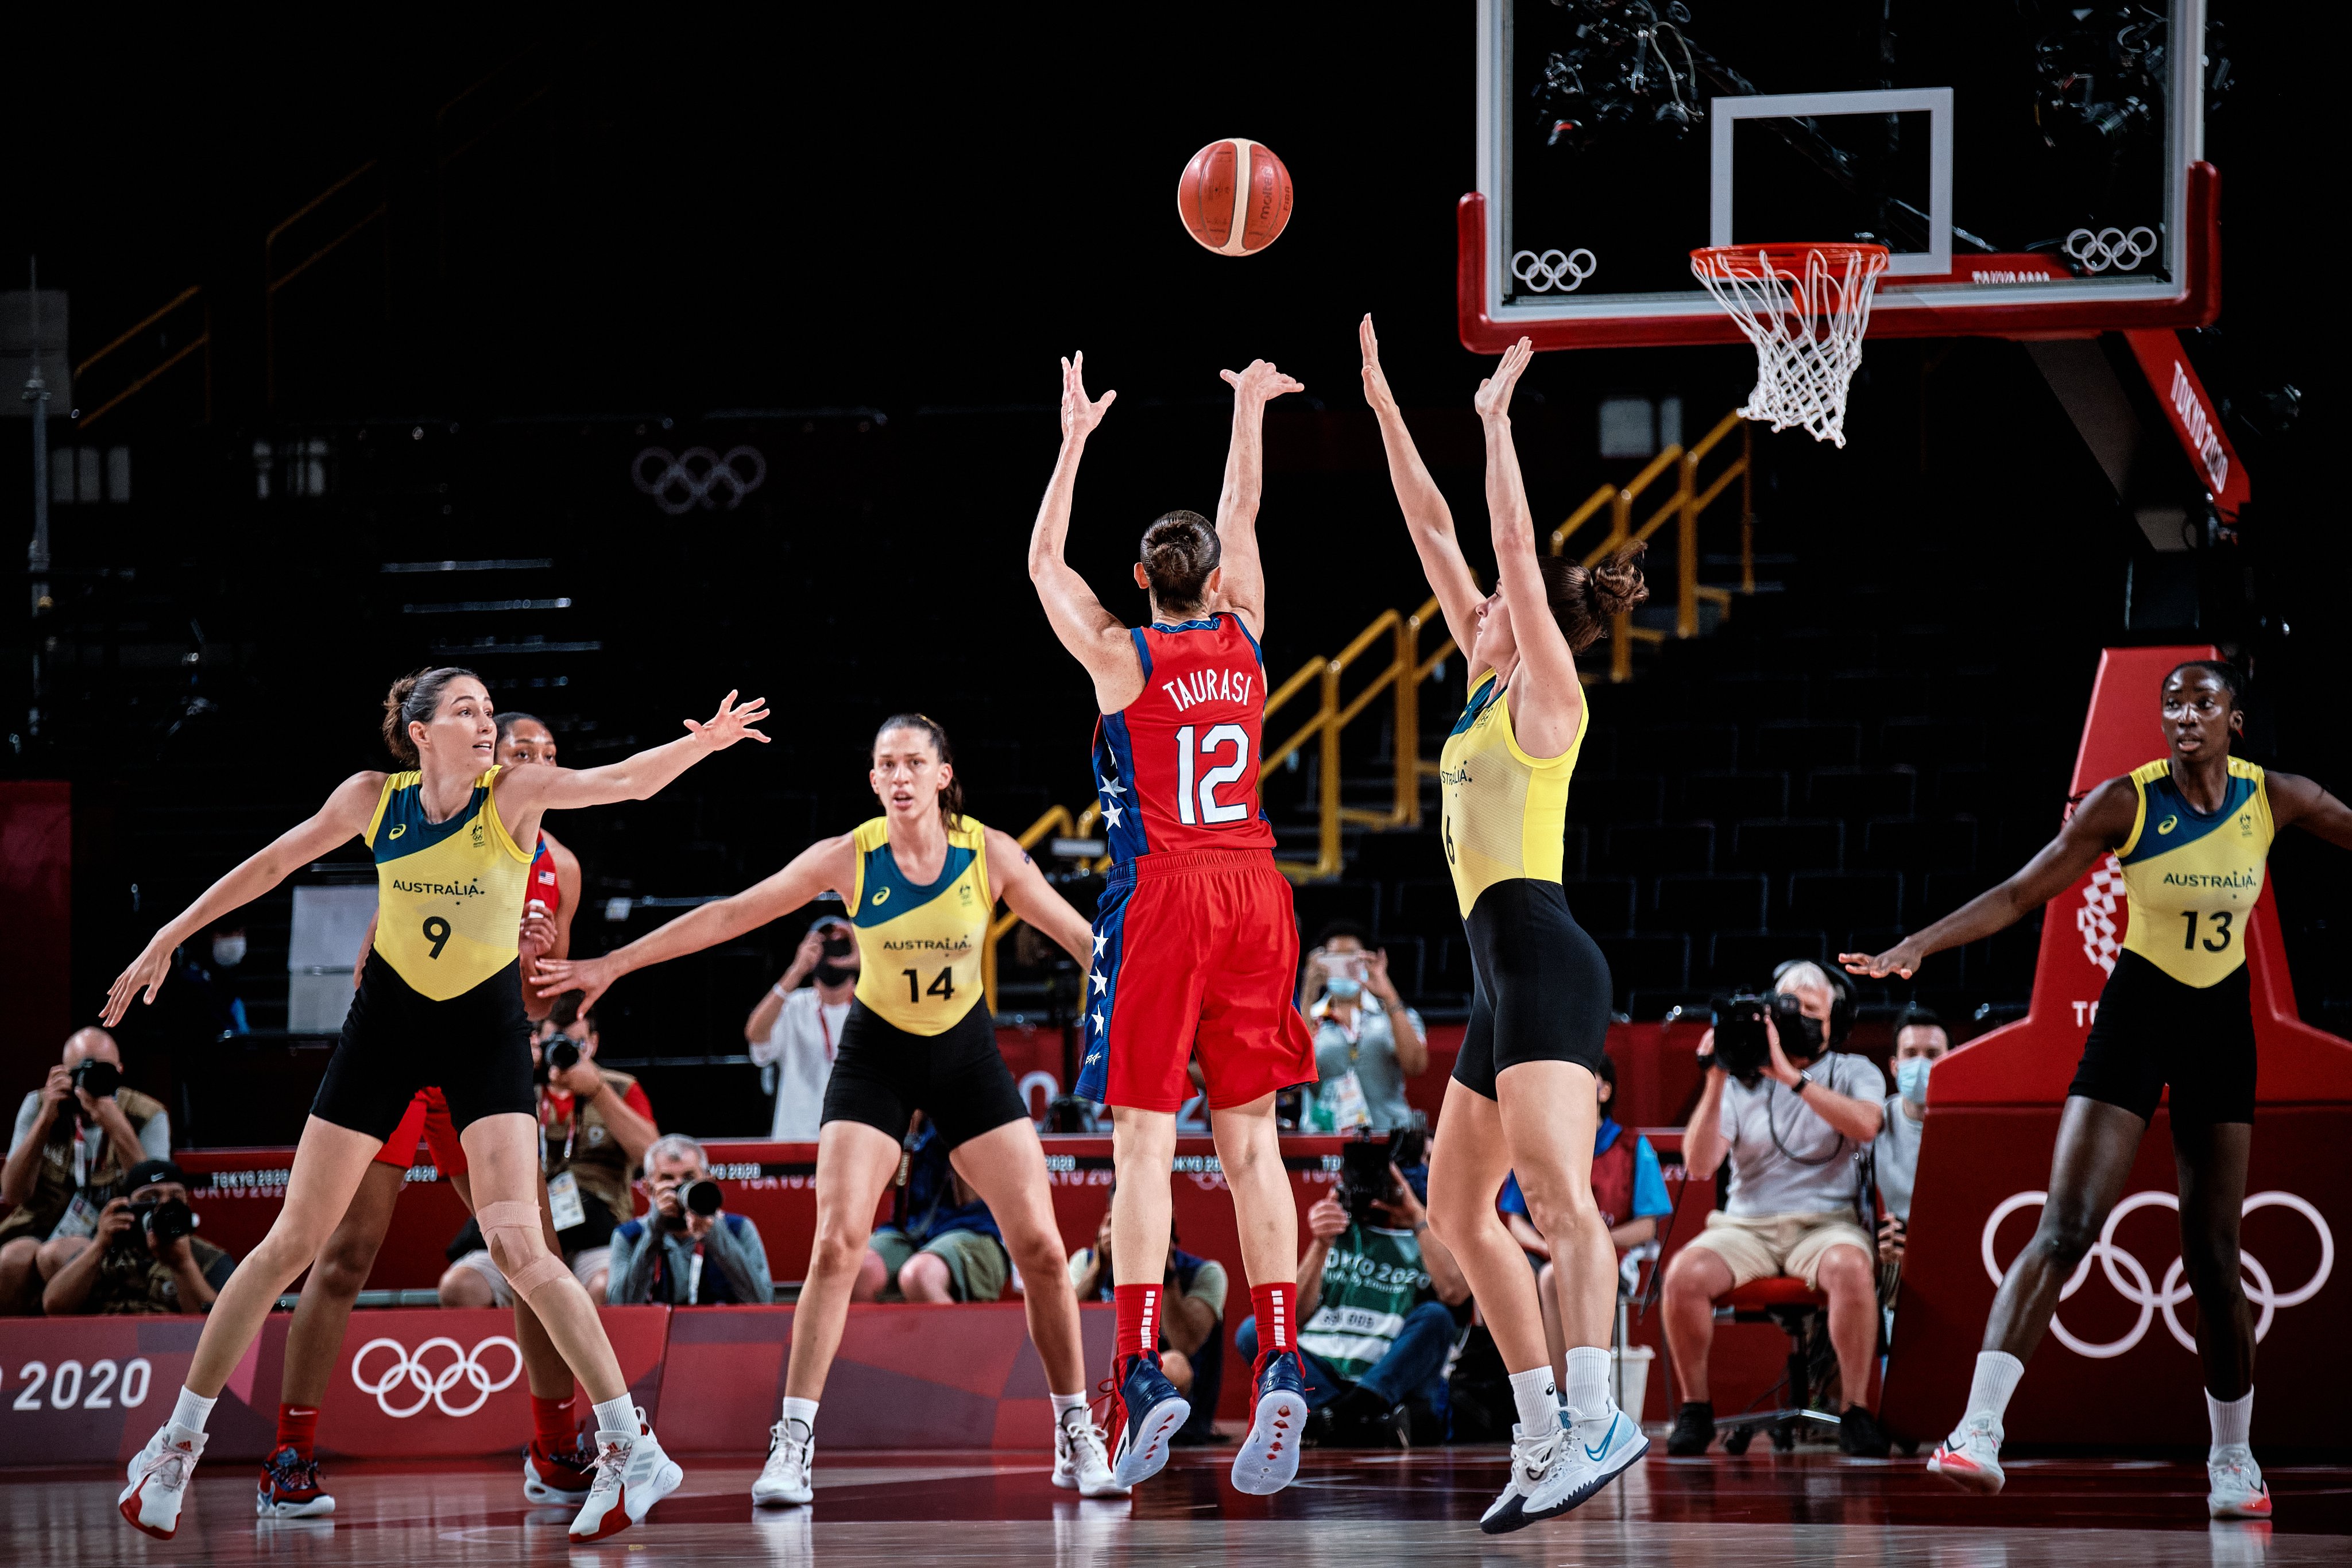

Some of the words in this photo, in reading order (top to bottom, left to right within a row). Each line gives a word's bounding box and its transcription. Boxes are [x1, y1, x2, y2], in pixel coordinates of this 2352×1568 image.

[1162, 668, 1252, 712] TAURASI
[1174, 723, 1250, 826] 12
[1446, 814, 1455, 865] 6
[393, 879, 479, 896] AUSTRALIA
[2163, 872, 2253, 888] AUSTRALIA
[422, 915, 451, 961] 9
[883, 939, 968, 951] AUSTRALIA
[2180, 911, 2233, 953] 13
[902, 965, 955, 1004] 14
[12, 1357, 152, 1411] 2020
